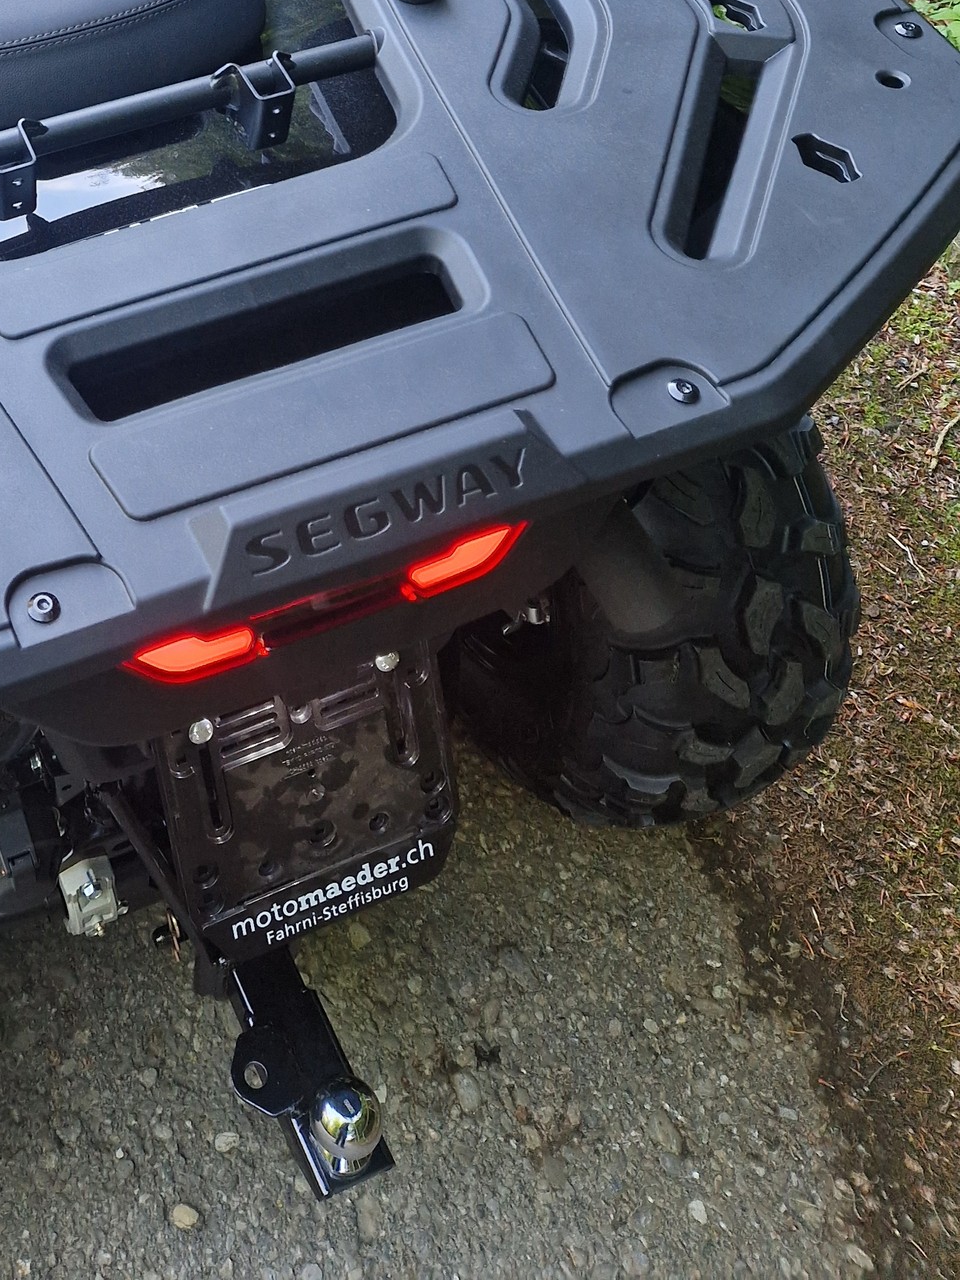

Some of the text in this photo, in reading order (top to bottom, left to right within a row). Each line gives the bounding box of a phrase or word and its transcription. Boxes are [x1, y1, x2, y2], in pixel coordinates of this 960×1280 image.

[245, 448, 528, 577] SEGWAY
[231, 839, 435, 940] motomaeder.ch
[266, 875, 410, 945] Fahrni-Steffisburg
